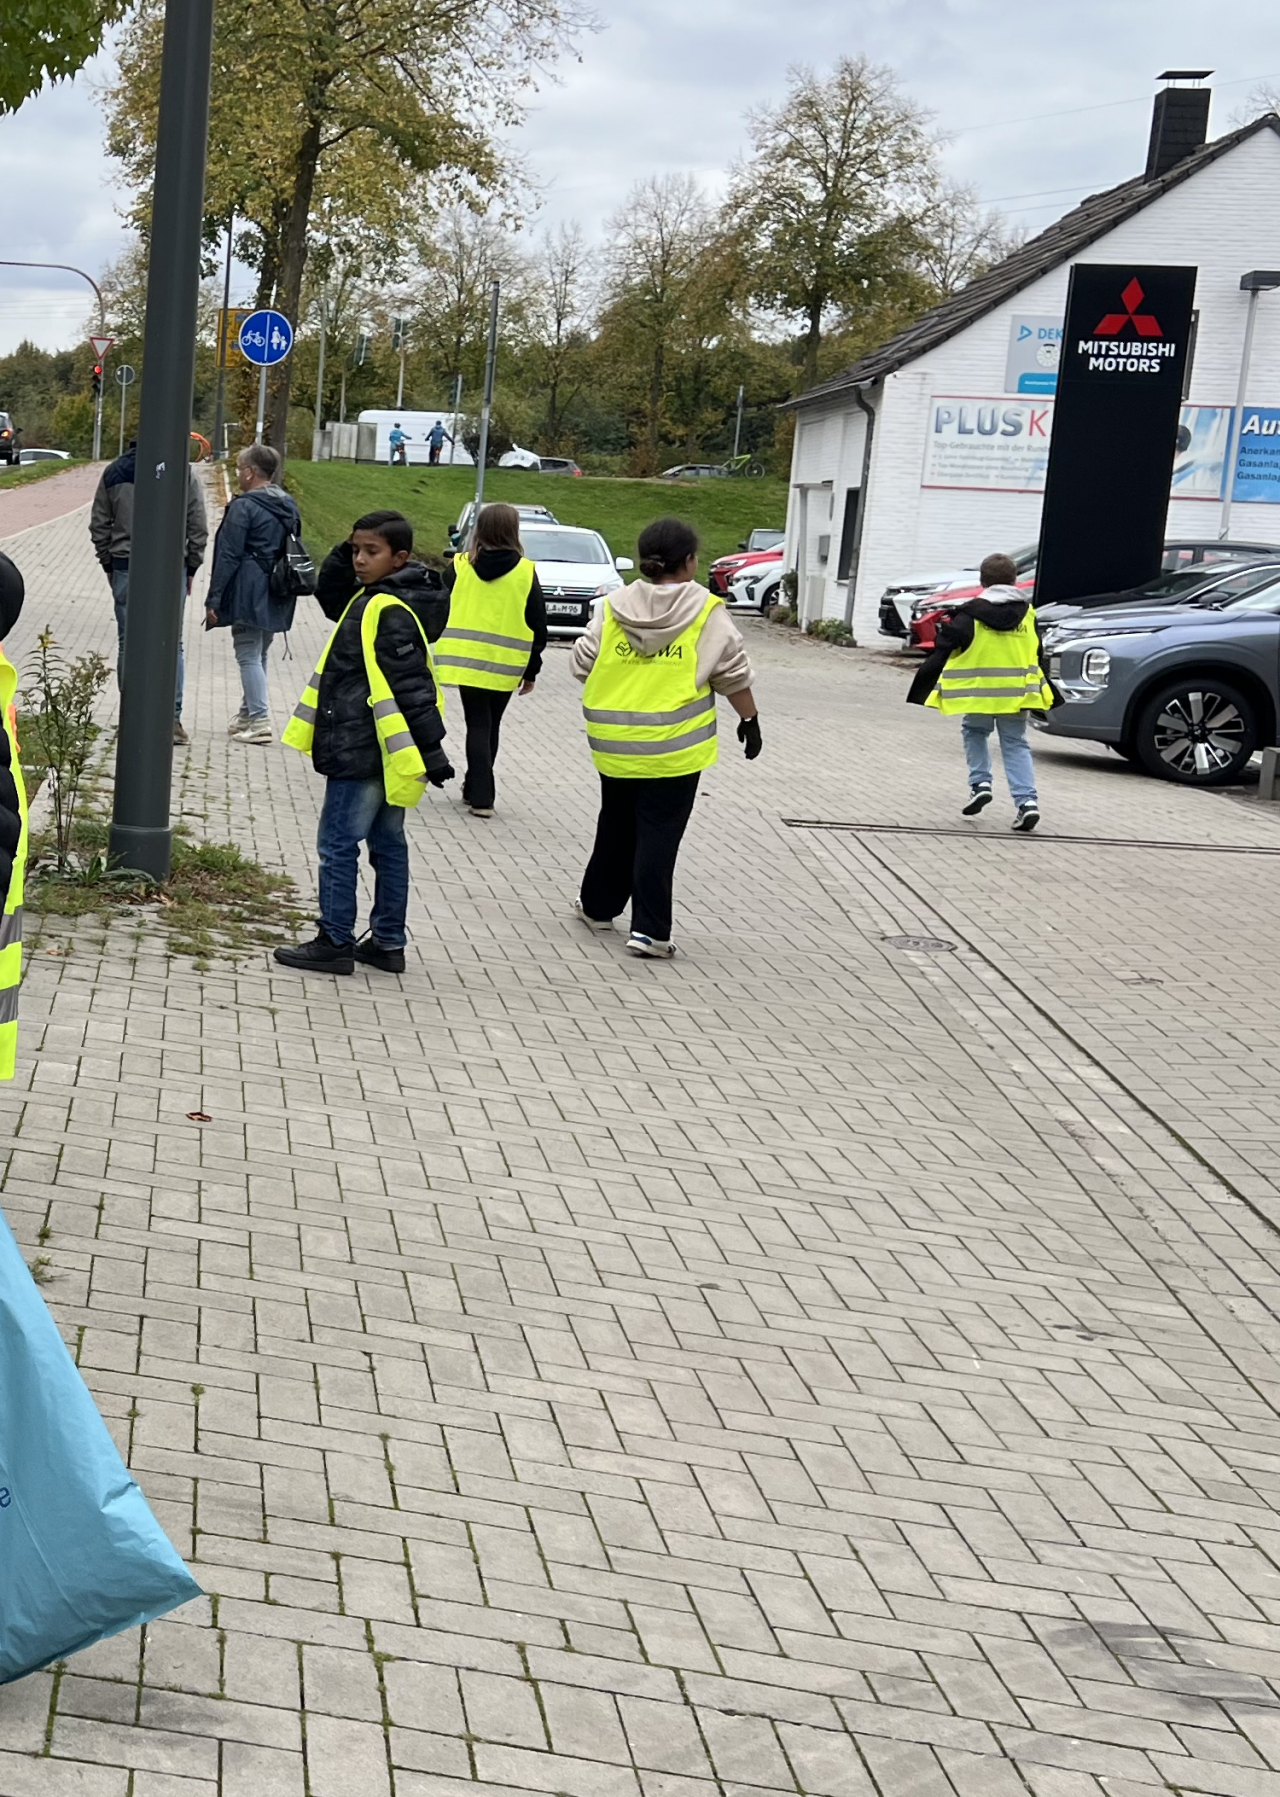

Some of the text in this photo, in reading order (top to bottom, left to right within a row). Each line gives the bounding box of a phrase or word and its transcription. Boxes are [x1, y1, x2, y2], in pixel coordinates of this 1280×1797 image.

[1077, 340, 1176, 357] MITSUBISHI
[1088, 357, 1161, 373] MOTORS
[933, 441, 1050, 454] Top-Gebrauchte mit der Rund
